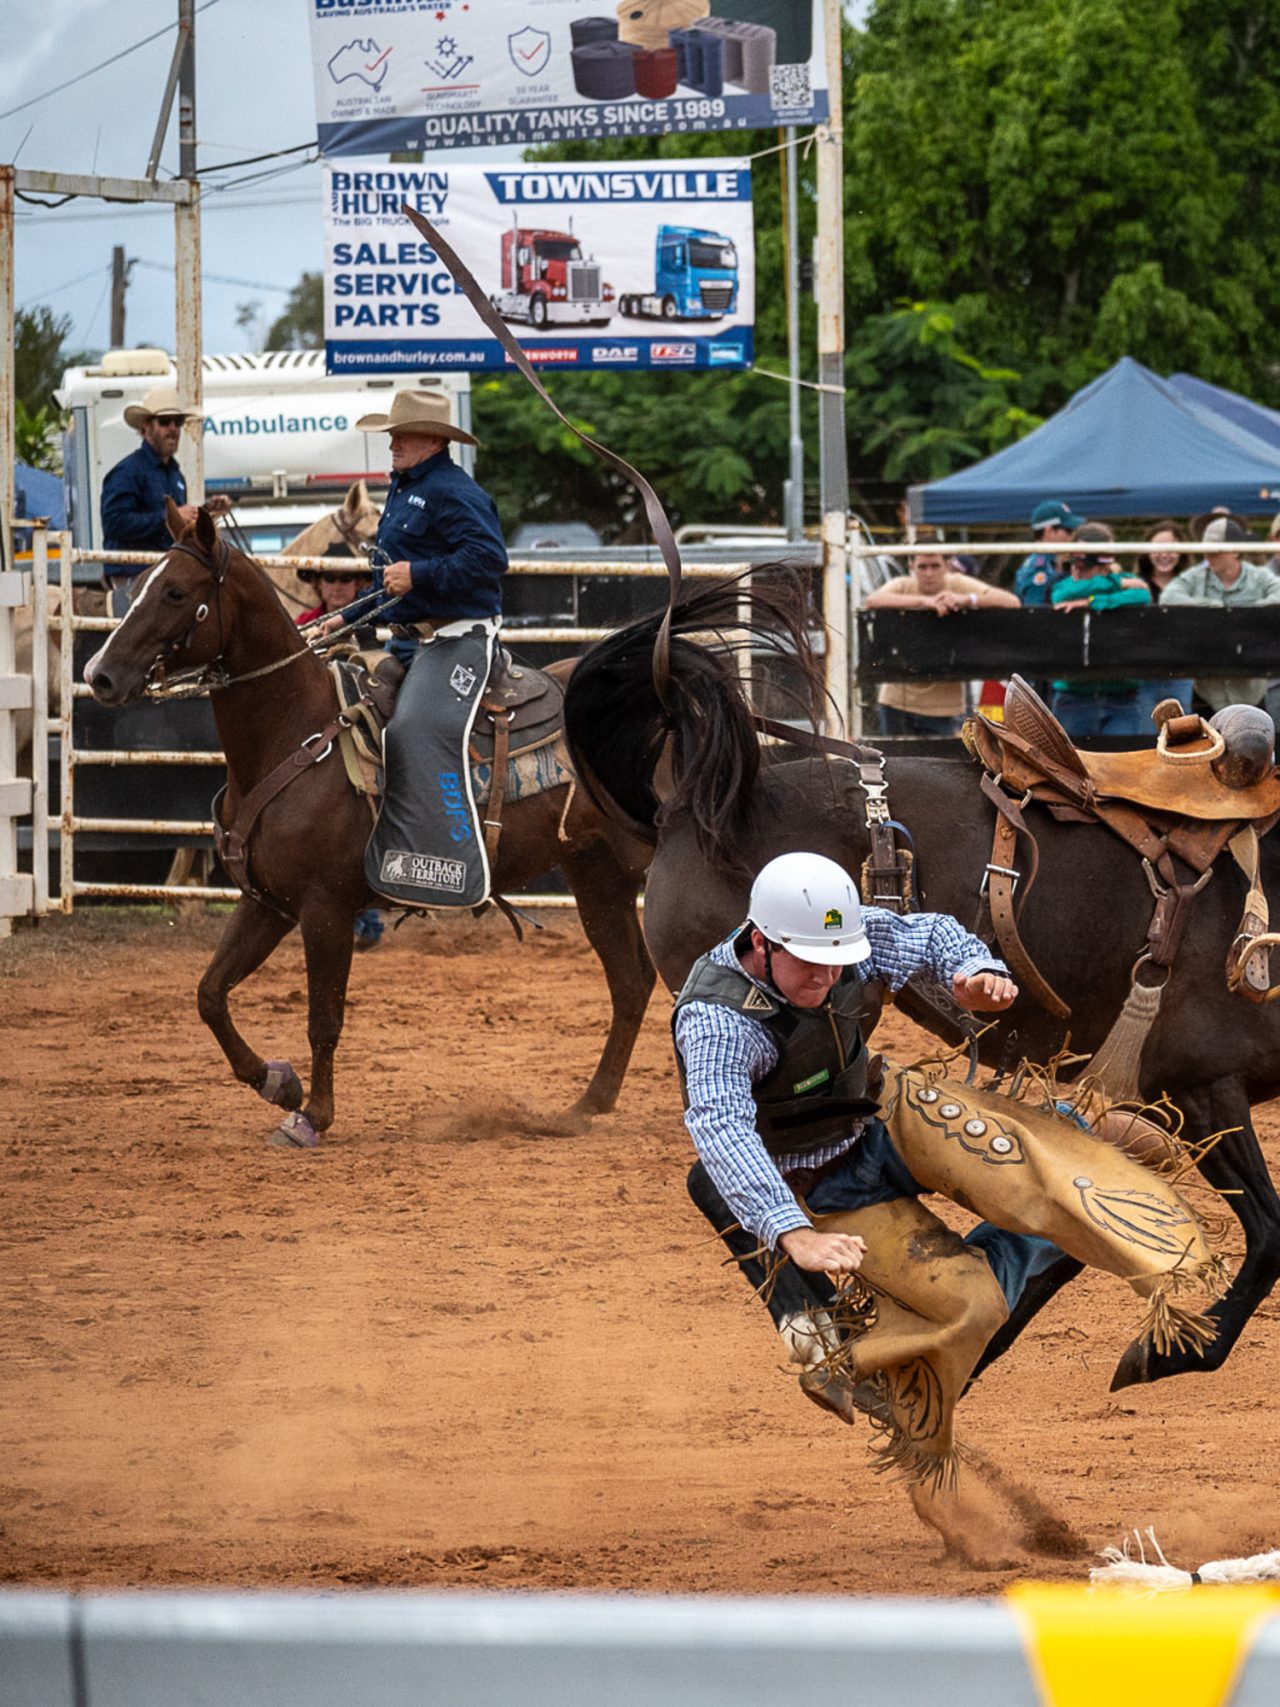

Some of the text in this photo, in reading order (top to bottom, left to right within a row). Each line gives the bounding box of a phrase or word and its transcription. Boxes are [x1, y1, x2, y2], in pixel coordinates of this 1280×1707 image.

[316, 10, 351, 18] SAVING
[354, 5, 416, 15] AUSTRALIA'S
[418, 2, 451, 11] WATER
[425, 99, 726, 137] QUALITY TANKS SINCE 1989
[331, 172, 448, 191] BROWN
[498, 173, 739, 199] TOWNSVILLE
[333, 217, 351, 226] The
[354, 217, 372, 226] BIG
[333, 242, 438, 265] SALES
[334, 303, 441, 327] PARTS
[333, 351, 485, 366] brownandhurley.com.au
[592, 347, 638, 358] DAF
[203, 414, 348, 436] Ambulance
[412, 857, 463, 875] OUTBACK
[411, 867, 463, 886] TERRITORY
